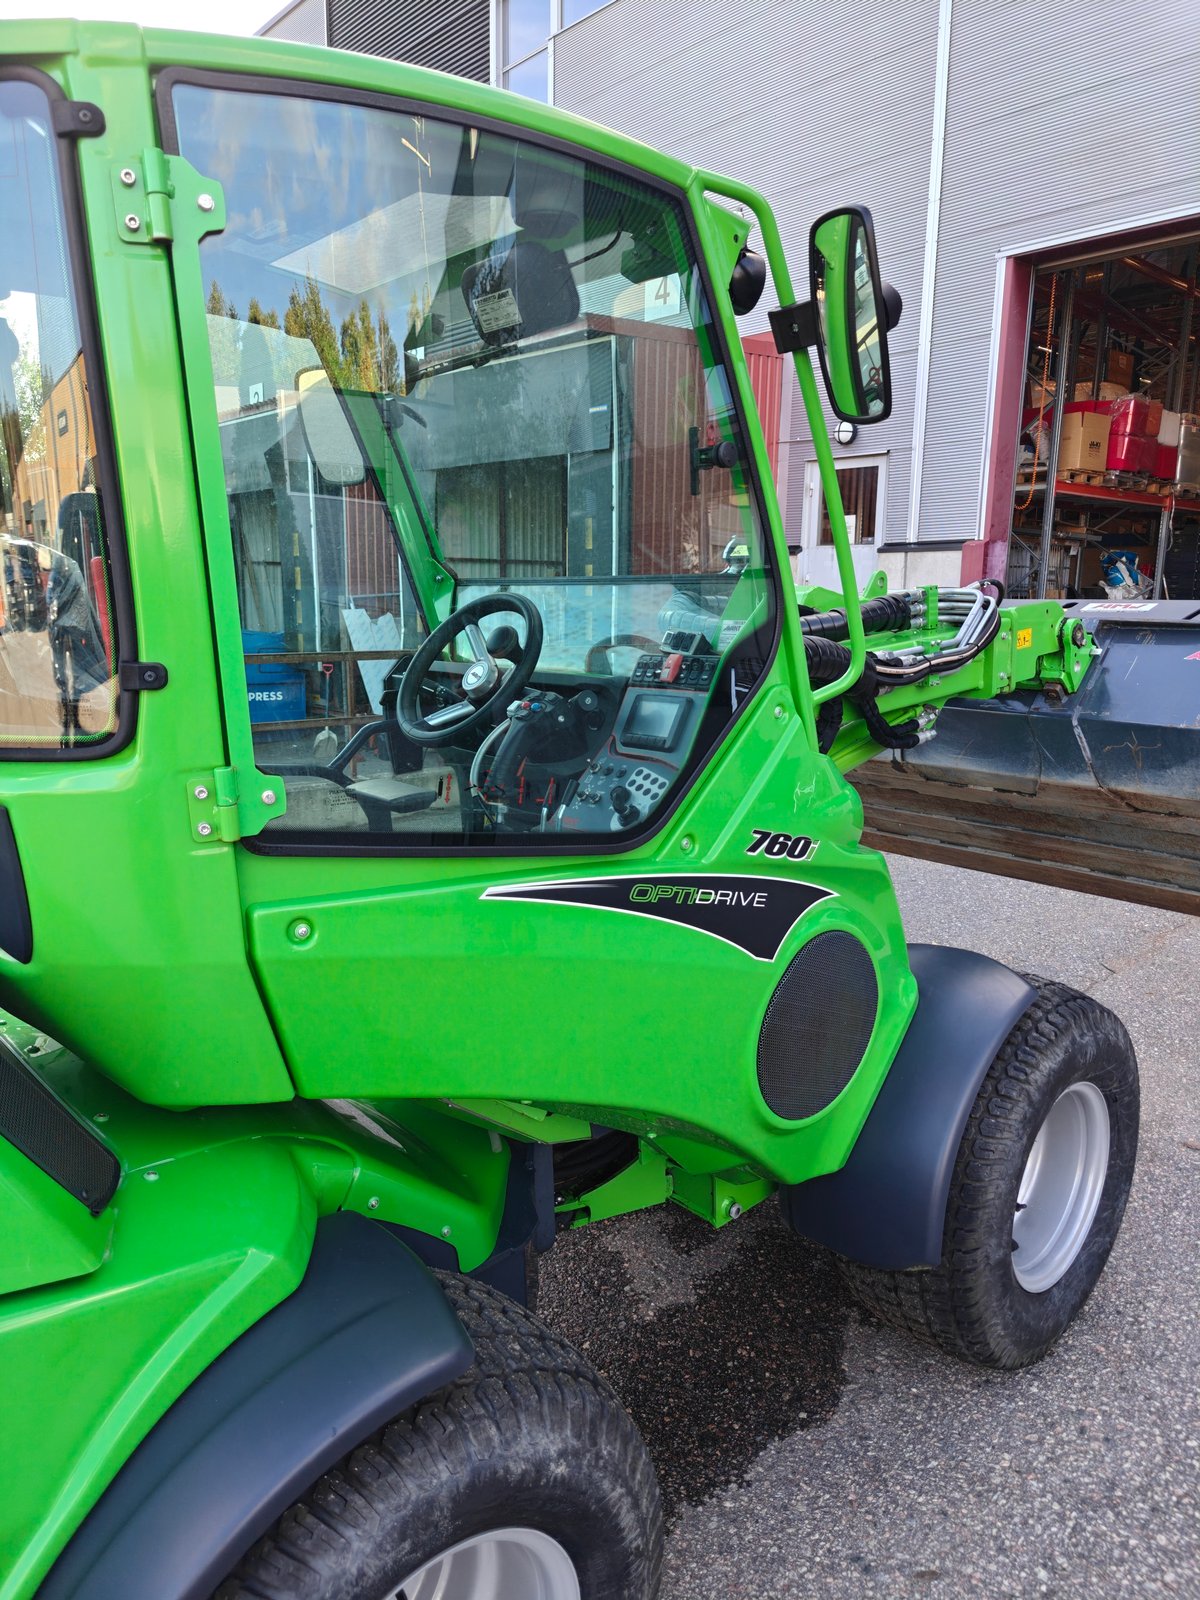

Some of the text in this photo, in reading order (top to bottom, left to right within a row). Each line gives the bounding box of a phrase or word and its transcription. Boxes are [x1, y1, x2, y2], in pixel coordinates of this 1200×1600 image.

[654, 276, 670, 305] 4
[248, 691, 283, 702] PRESS
[745, 829, 820, 861] 760i
[629, 884, 768, 907] OPTIDRIVE
